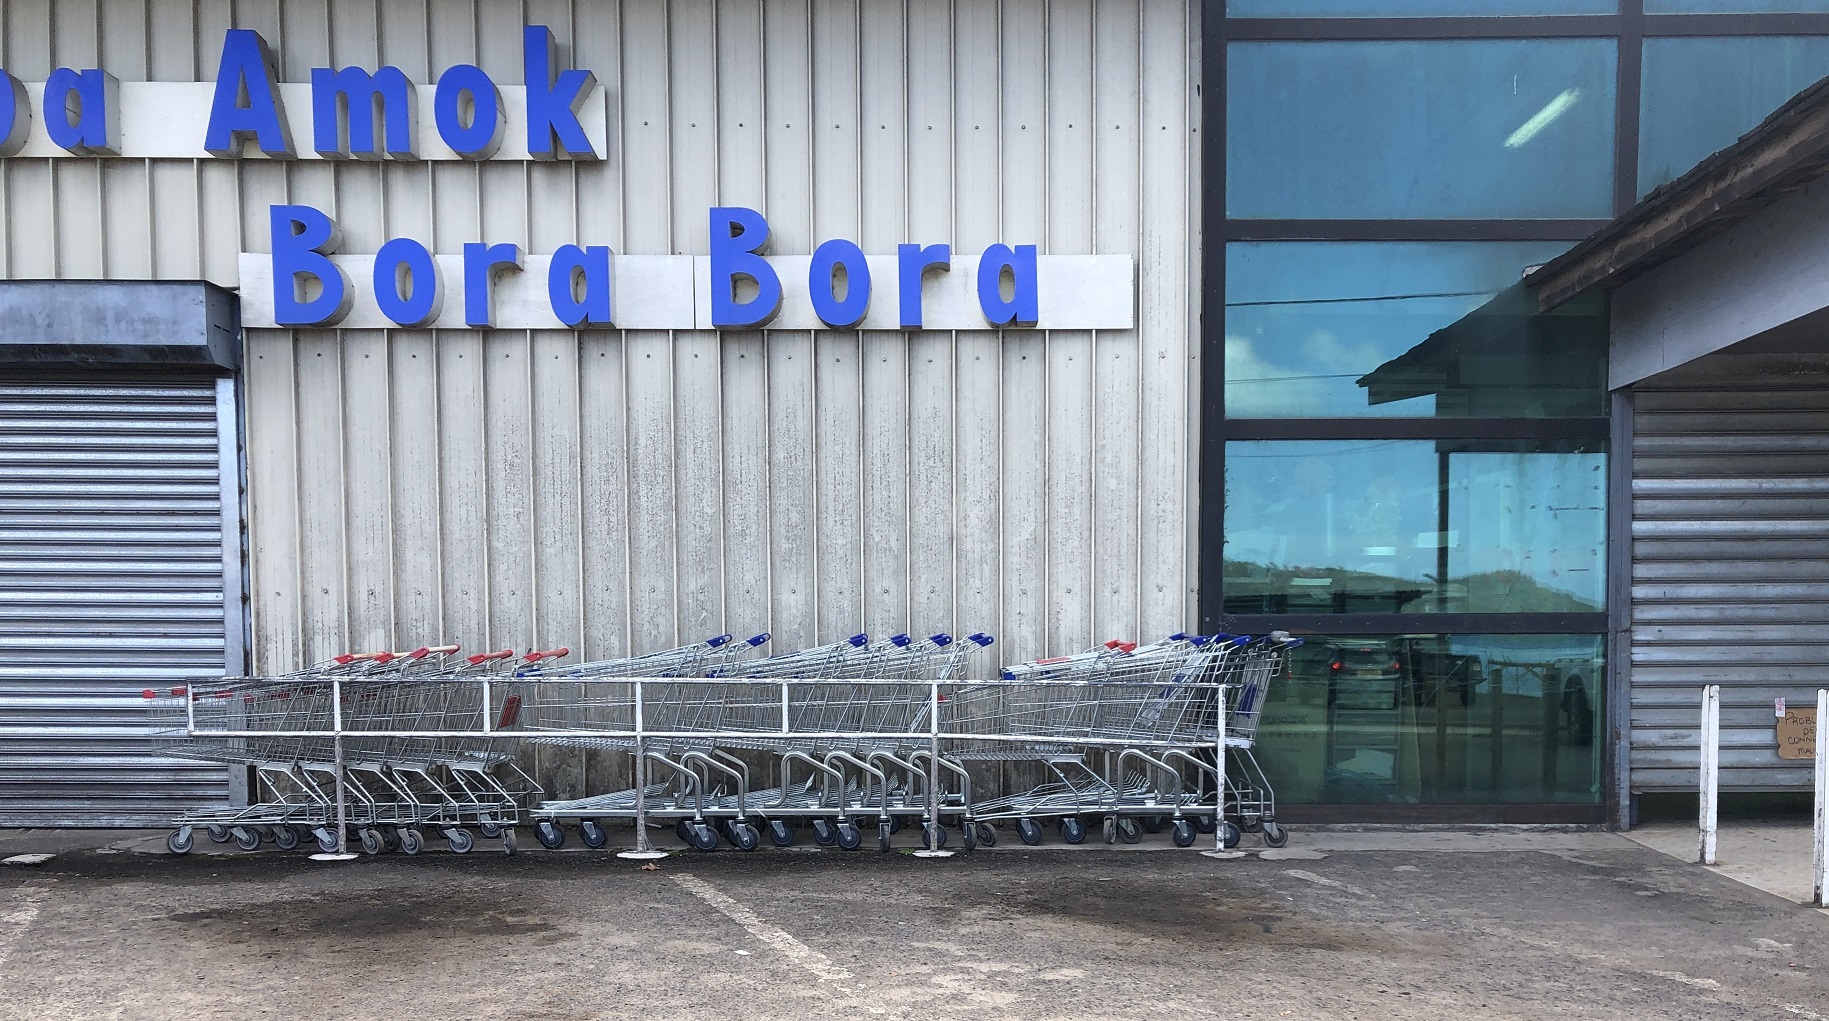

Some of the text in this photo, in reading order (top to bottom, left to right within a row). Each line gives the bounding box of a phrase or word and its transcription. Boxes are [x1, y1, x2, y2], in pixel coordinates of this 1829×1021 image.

[0, 25, 597, 157] a Amok
[269, 204, 1039, 327] Bora Bora
[1785, 711, 1817, 725] PROBL
